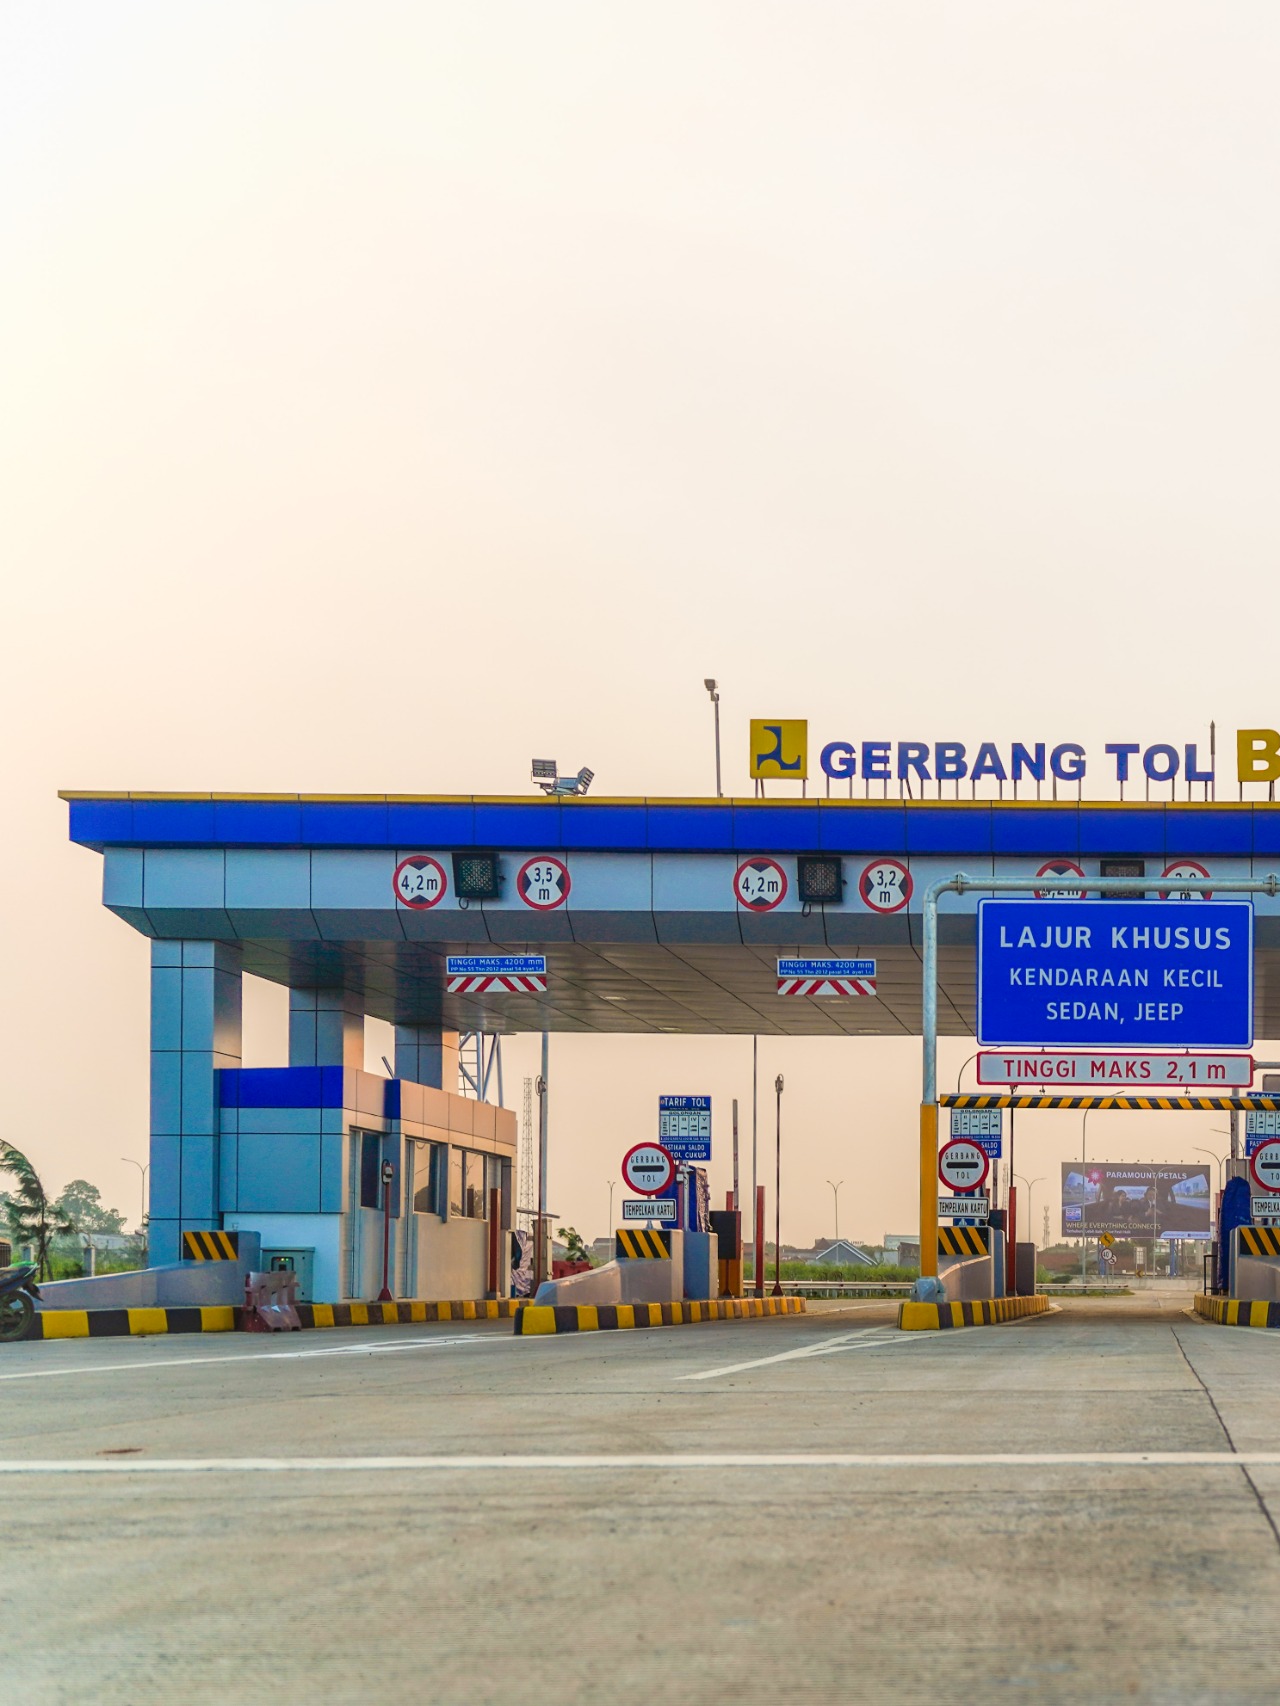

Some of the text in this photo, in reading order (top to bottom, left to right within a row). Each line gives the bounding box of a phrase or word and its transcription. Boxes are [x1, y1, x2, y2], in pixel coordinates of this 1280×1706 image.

[820, 741, 1086, 780] GERBANG
[1105, 743, 1214, 781] TOL
[534, 867, 553, 885] 3,5
[877, 870, 896, 888] 3,2
[538, 888, 550, 900] m
[879, 891, 891, 903] m
[1000, 926, 1231, 950] LAJUR KHUSUS
[450, 958, 476, 966] TINGGI
[504, 958, 525, 966] 4200
[1010, 967, 1223, 988] KENDARAAN KECIL
[1046, 1002, 1184, 1025] SEDAN, JEEP
[1003, 1059, 1226, 1082] TINGGI MAKS 2,1 m
[664, 1097, 707, 1107] TARIF TOL
[631, 1155, 666, 1163] GERBANG
[945, 1152, 980, 1160] GERBANG
[642, 1174, 656, 1182] TOL
[956, 1171, 970, 1179] TOL
[1106, 1171, 1187, 1180] PARAMOUNT PETALS
[625, 1205, 673, 1216] TEMPELKAN KARTU
[939, 1202, 987, 1213] TEMPELKAN KARTU
